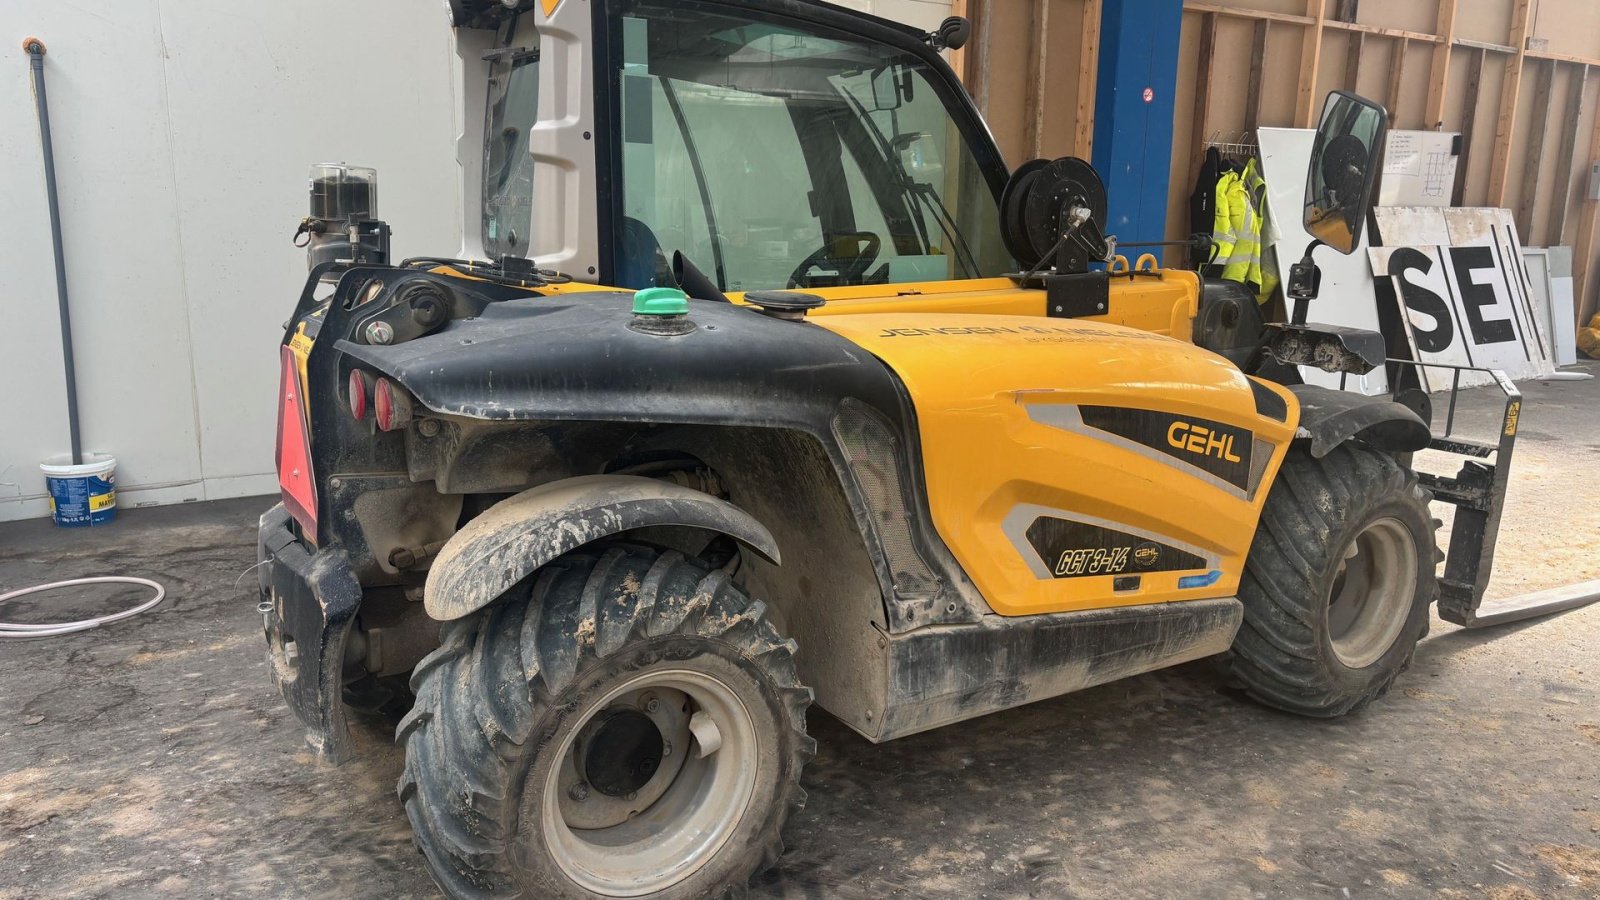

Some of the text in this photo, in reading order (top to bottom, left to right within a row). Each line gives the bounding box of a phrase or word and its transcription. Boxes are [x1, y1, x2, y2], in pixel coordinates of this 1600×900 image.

[879, 326, 1018, 337] JENSEN
[1167, 421, 1241, 463] GEHL
[1089, 546, 1131, 573] 3-14
[1134, 547, 1159, 557] GEHL
